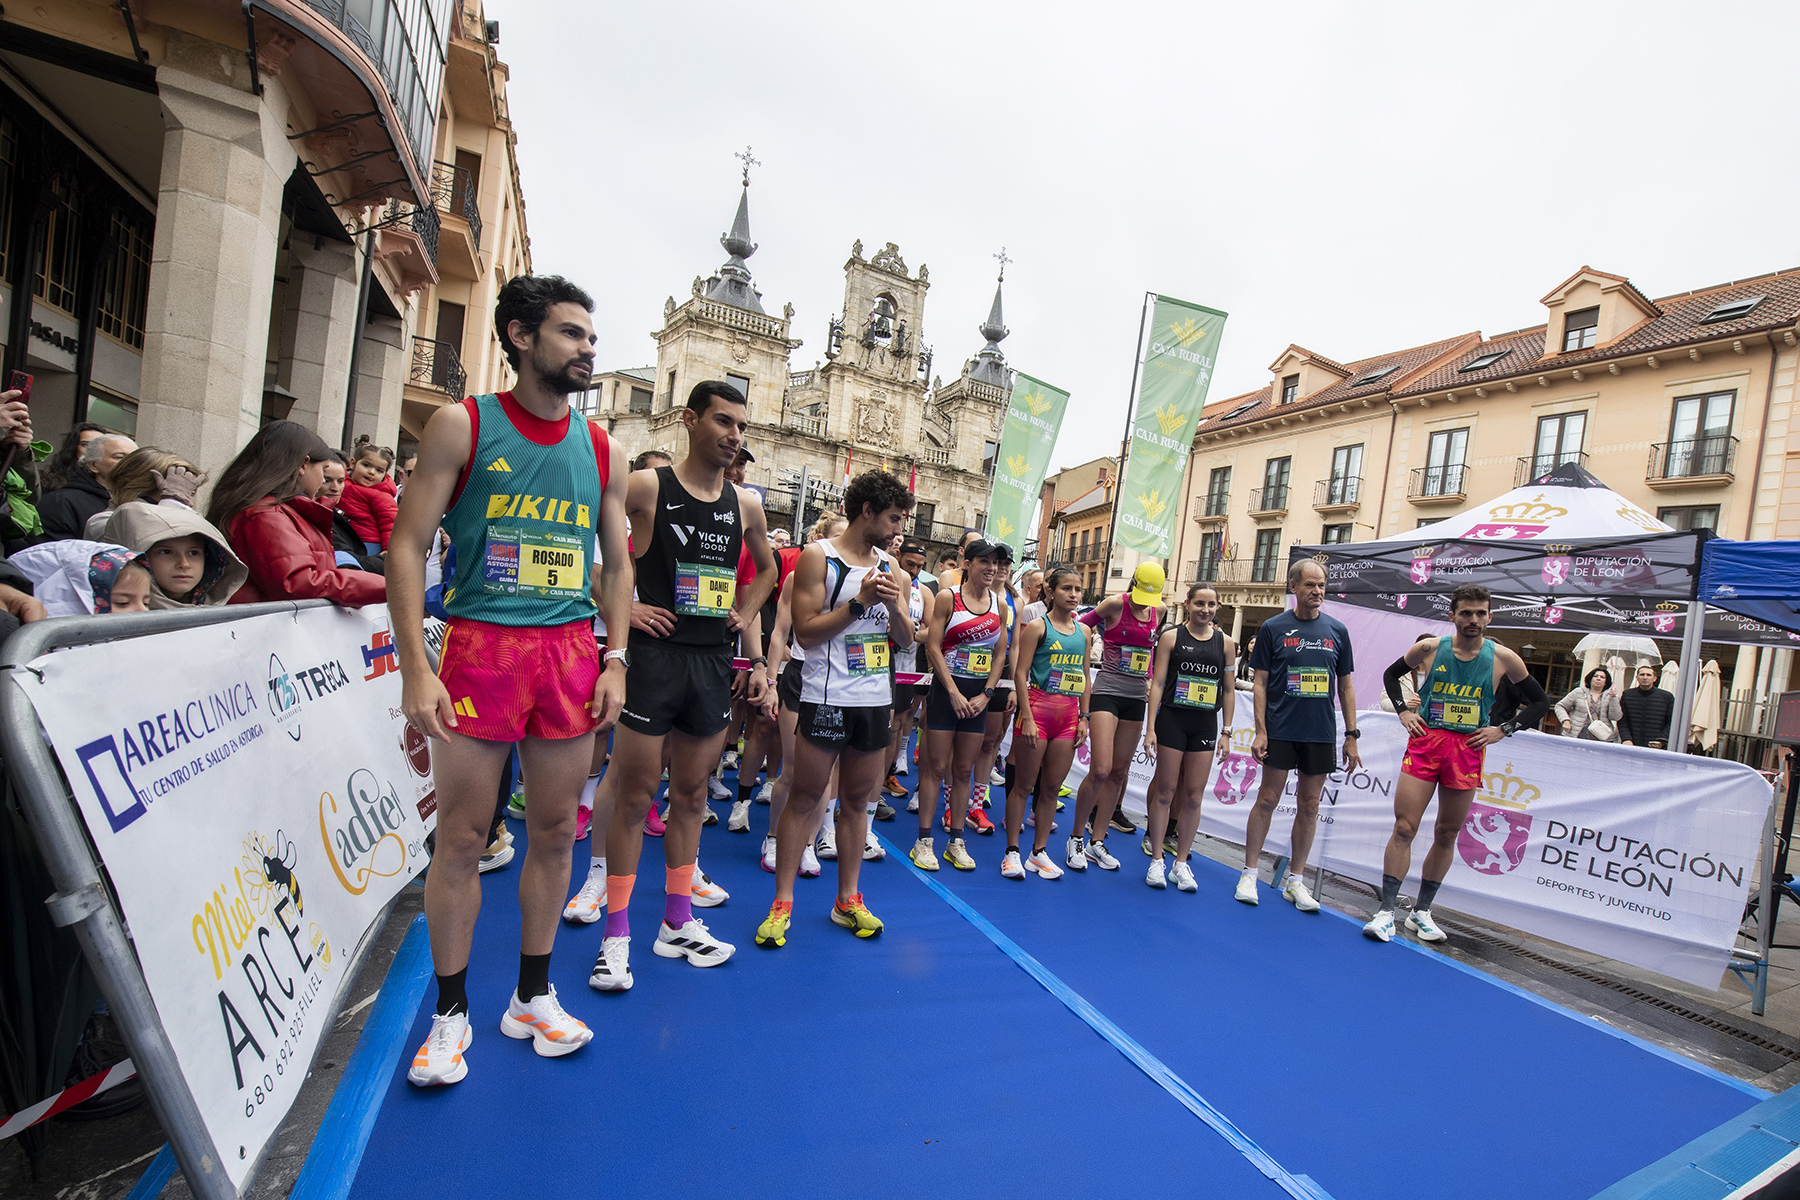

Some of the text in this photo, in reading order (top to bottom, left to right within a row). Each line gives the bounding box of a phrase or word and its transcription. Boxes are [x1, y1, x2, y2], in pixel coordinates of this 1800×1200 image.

[1152, 342, 1212, 369] CAJA RURAL
[1155, 361, 1177, 373] somos
[1009, 407, 1055, 433] CAJA RURAL
[1136, 427, 1190, 455] CAJA RURAL
[1009, 478, 1035, 494] RURAL
[485, 494, 590, 529] BIKILA
[1122, 513, 1169, 539] CAJA RURAL
[698, 531, 731, 545] VICKY
[490, 544, 517, 559] 10K
[700, 542, 727, 552] FOODS
[487, 561, 518, 569] ASTORGA
[532, 549, 574, 568] ROSADO
[1435, 555, 1493, 566] DIPUTACIÓN
[1575, 554, 1652, 566] DIPUTACIÓN
[1329, 560, 1374, 571] DIPUTACIÓN
[1435, 565, 1473, 575] DE LEÓN
[1573, 566, 1625, 577] DE LEÓN
[547, 569, 558, 586] 5
[1330, 569, 1359, 579] DE LEÓN
[678, 577, 698, 587] 10K
[709, 580, 729, 593] DANIEL
[716, 594, 723, 608] 8
[1221, 593, 1239, 604] TEL
[971, 629, 992, 642] FER
[1283, 637, 1300, 647] 10K
[872, 645, 885, 654] KEVIN
[876, 656, 882, 667] 3
[976, 654, 987, 665] 28
[1137, 662, 1142, 670] 9
[1180, 661, 1218, 675] OYSHO
[295, 659, 350, 701] TRECA
[1314, 674, 1328, 683] ANTÓN
[1069, 683, 1074, 691] 4
[1432, 681, 1482, 698] BIKILA
[1198, 693, 1204, 702] 6
[276, 705, 302, 723] ANIVERSARIO
[1450, 705, 1471, 714] CELADA
[1456, 714, 1463, 723] 2
[123, 681, 257, 772] AREACLINICA
[138, 723, 264, 806] TU CENTRO DE SALUD EN ASTORGA
[1128, 770, 1151, 781] UVENTUD
[319, 768, 407, 896] Cadiel
[1546, 820, 1744, 888] DIPUTACIÓN
[1540, 844, 1673, 898] DE LEÓN
[1536, 876, 1672, 921] DEPORTES Y JUVENTUD
[192, 866, 256, 981] Miel
[217, 895, 313, 1091] ARCE
[245, 972, 323, 1118] 680 692 925 FILIEL
